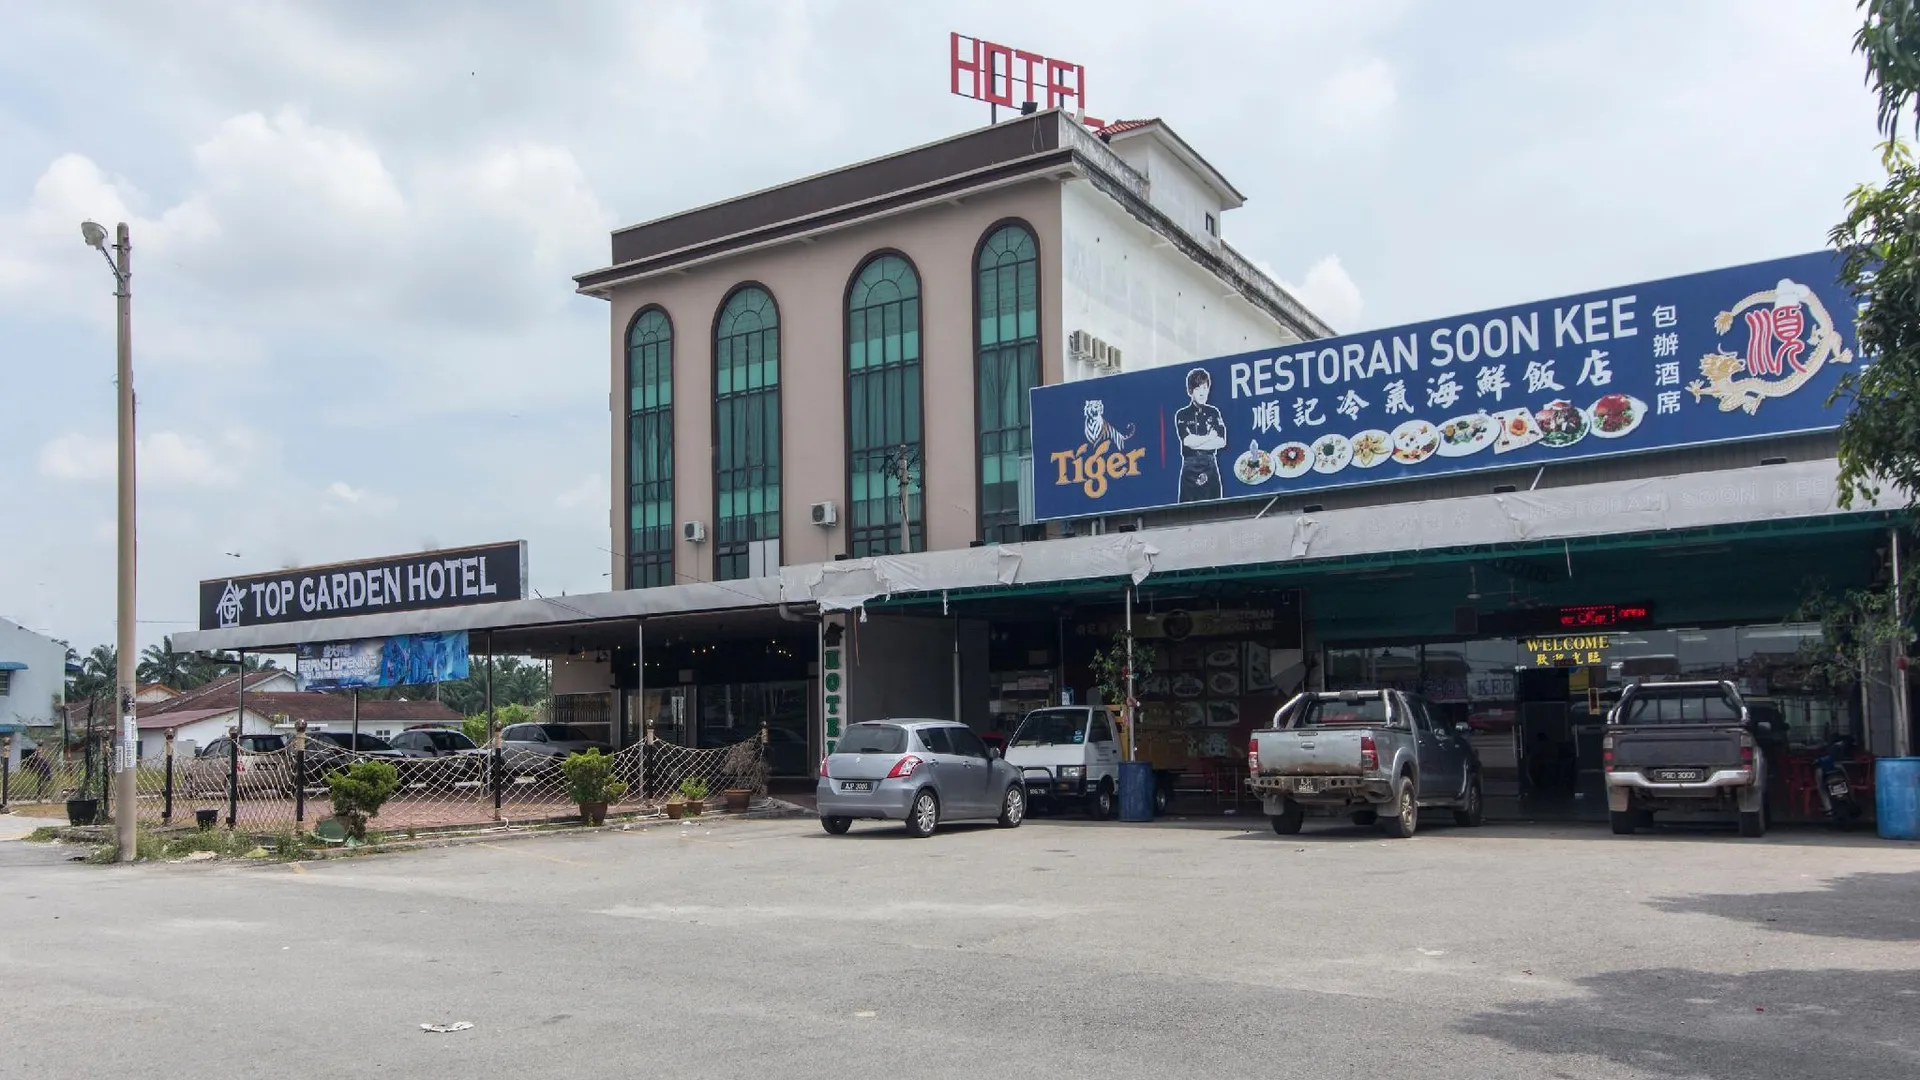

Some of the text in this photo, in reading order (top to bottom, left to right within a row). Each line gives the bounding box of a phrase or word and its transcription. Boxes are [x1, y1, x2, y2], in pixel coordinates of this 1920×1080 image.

[1231, 295, 1638, 399] RESTORAN SOON KEE
[1251, 350, 1613, 435] 順記冷氣海鮮飯店
[1051, 440, 1146, 498] Tiger
[251, 556, 497, 617] TOP GARDEN HOTEL
[298, 655, 377, 673] GRAND OPENING
[1527, 636, 1609, 652] WELCOME
